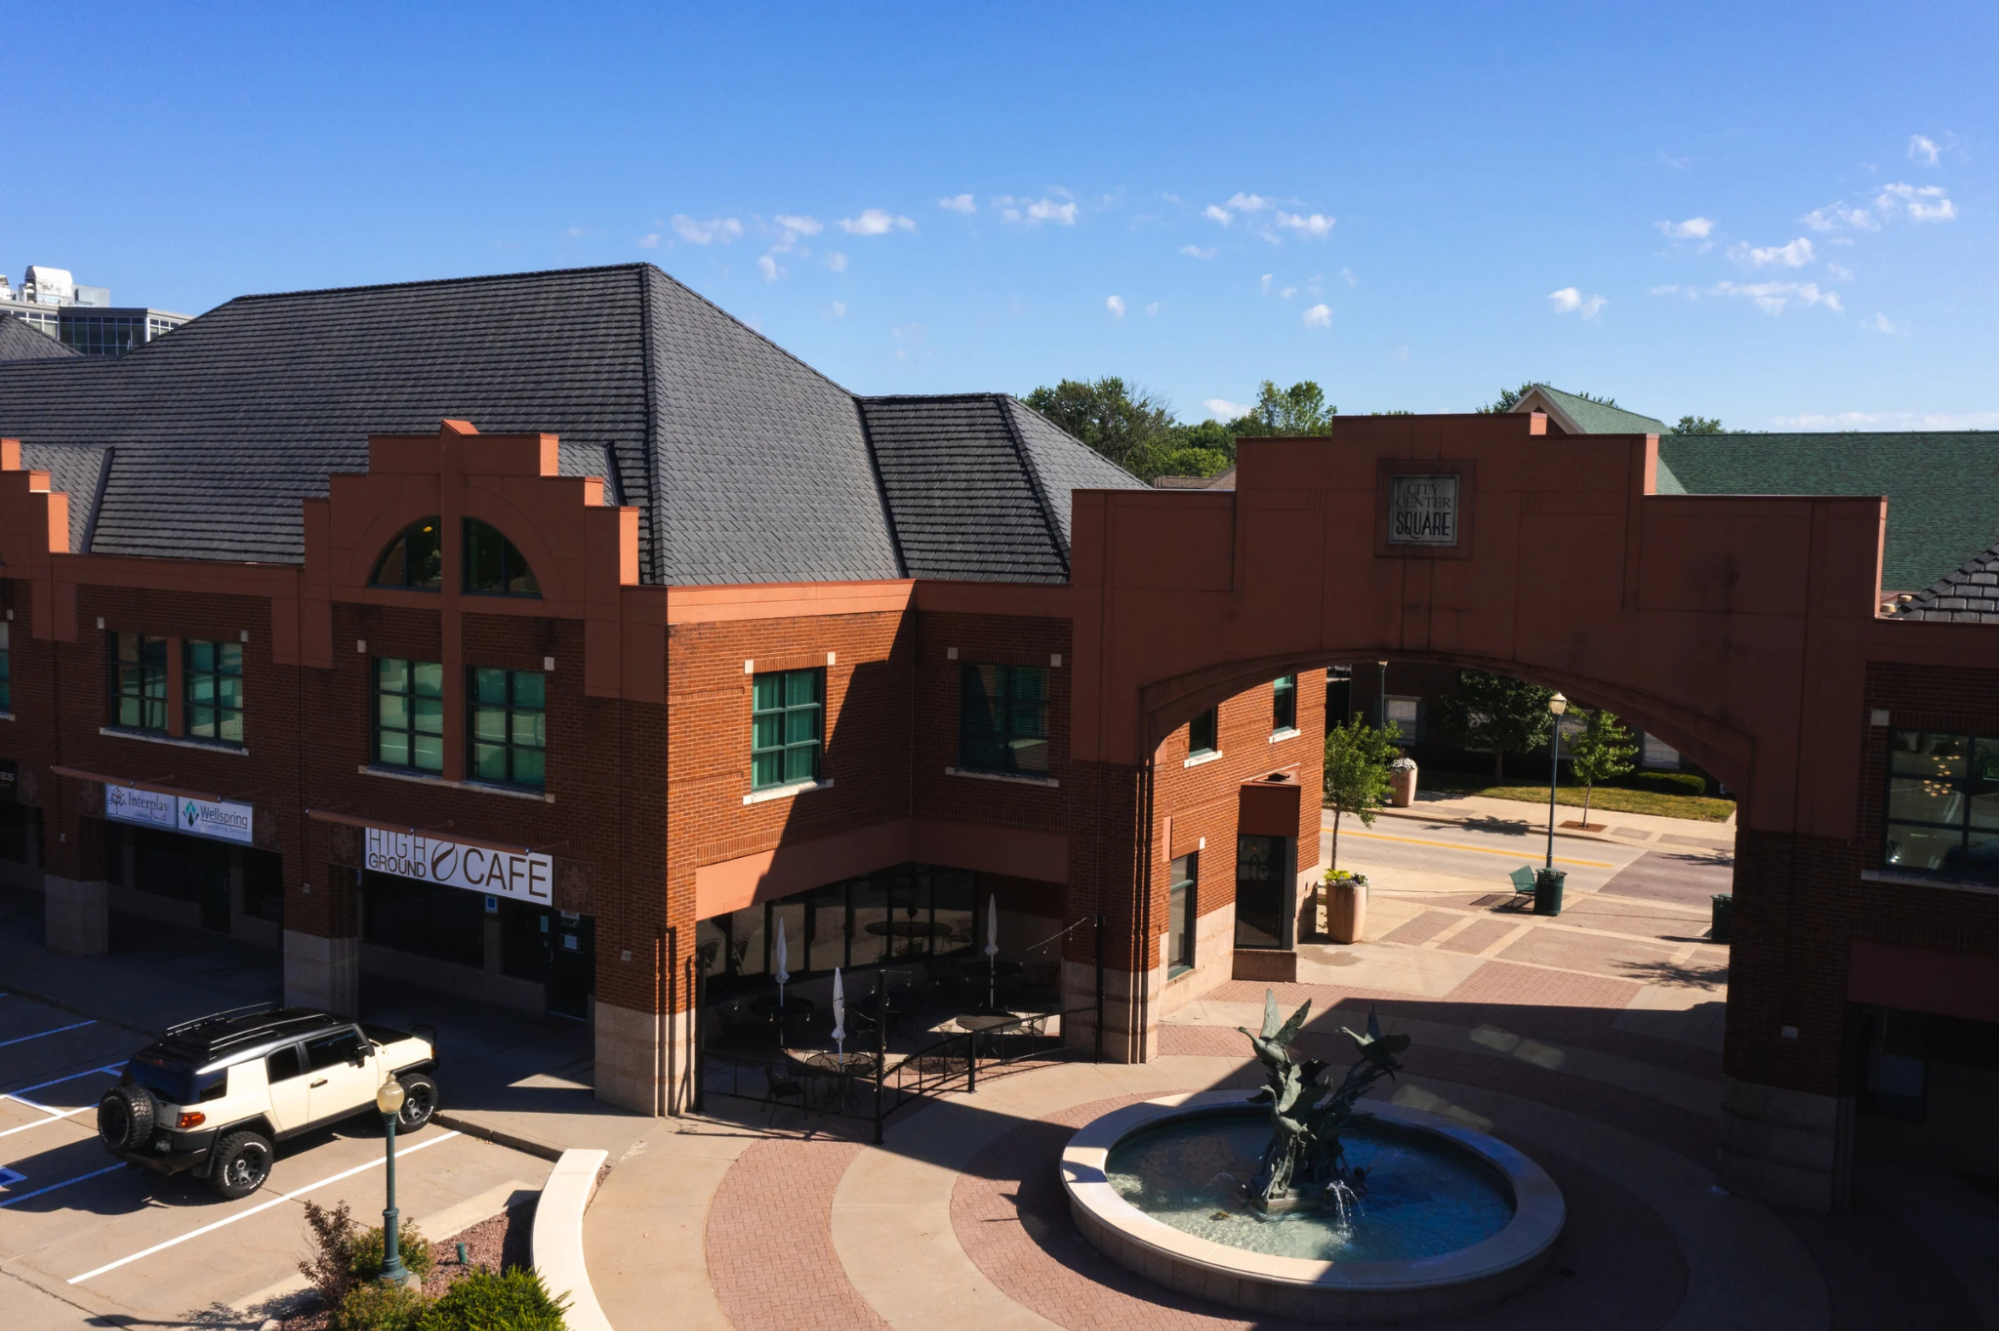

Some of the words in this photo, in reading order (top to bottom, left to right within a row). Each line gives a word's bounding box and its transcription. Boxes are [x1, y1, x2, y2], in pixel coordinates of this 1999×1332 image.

[1396, 497, 1451, 509] CENTER
[1407, 484, 1440, 496] CITY
[1396, 510, 1451, 540] SQUARE
[128, 791, 170, 818] Interplay
[200, 805, 248, 830] Wellspring
[369, 827, 426, 863] HIGH
[368, 852, 427, 878] GROUND
[463, 847, 548, 898] CAFE
